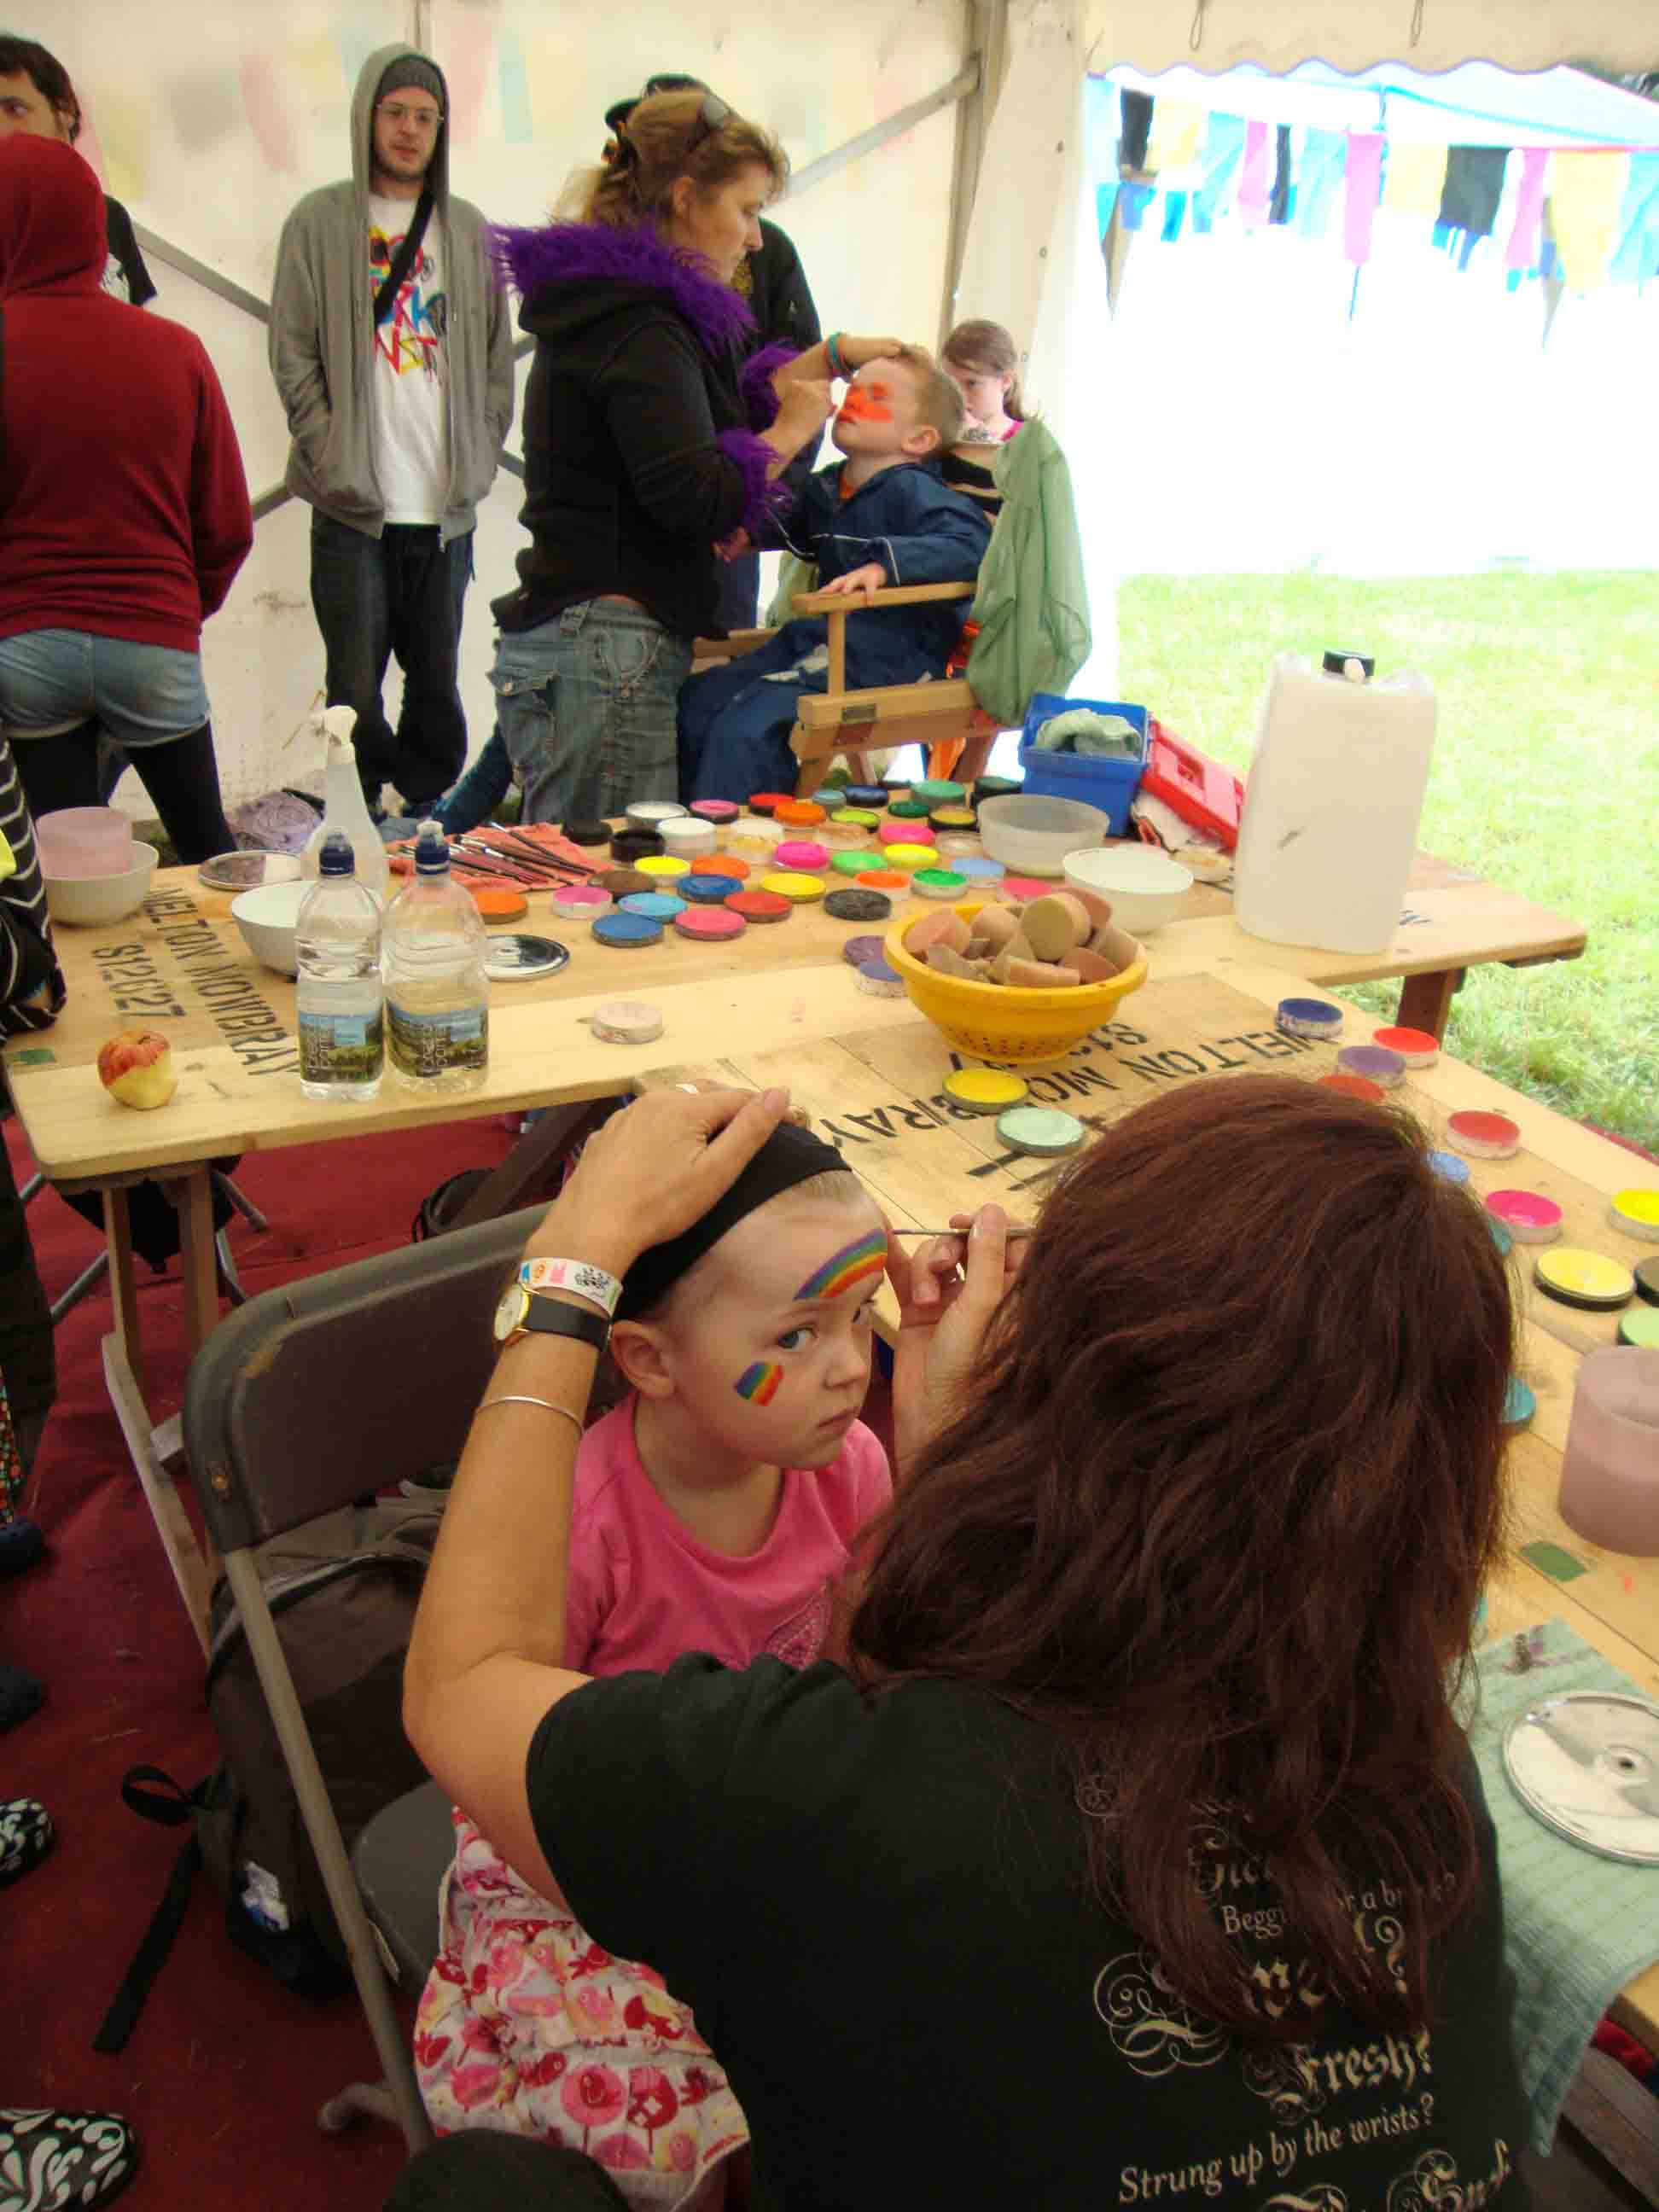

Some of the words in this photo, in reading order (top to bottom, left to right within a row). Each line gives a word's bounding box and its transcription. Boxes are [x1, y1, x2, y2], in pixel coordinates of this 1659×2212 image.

[1118, 2157, 1224, 2203] Strung
[1230, 2143, 1263, 2186] up
[1269, 2130, 1297, 2178] by
[1305, 2118, 1344, 2157] the
[1348, 2091, 1435, 2145] wrists?
